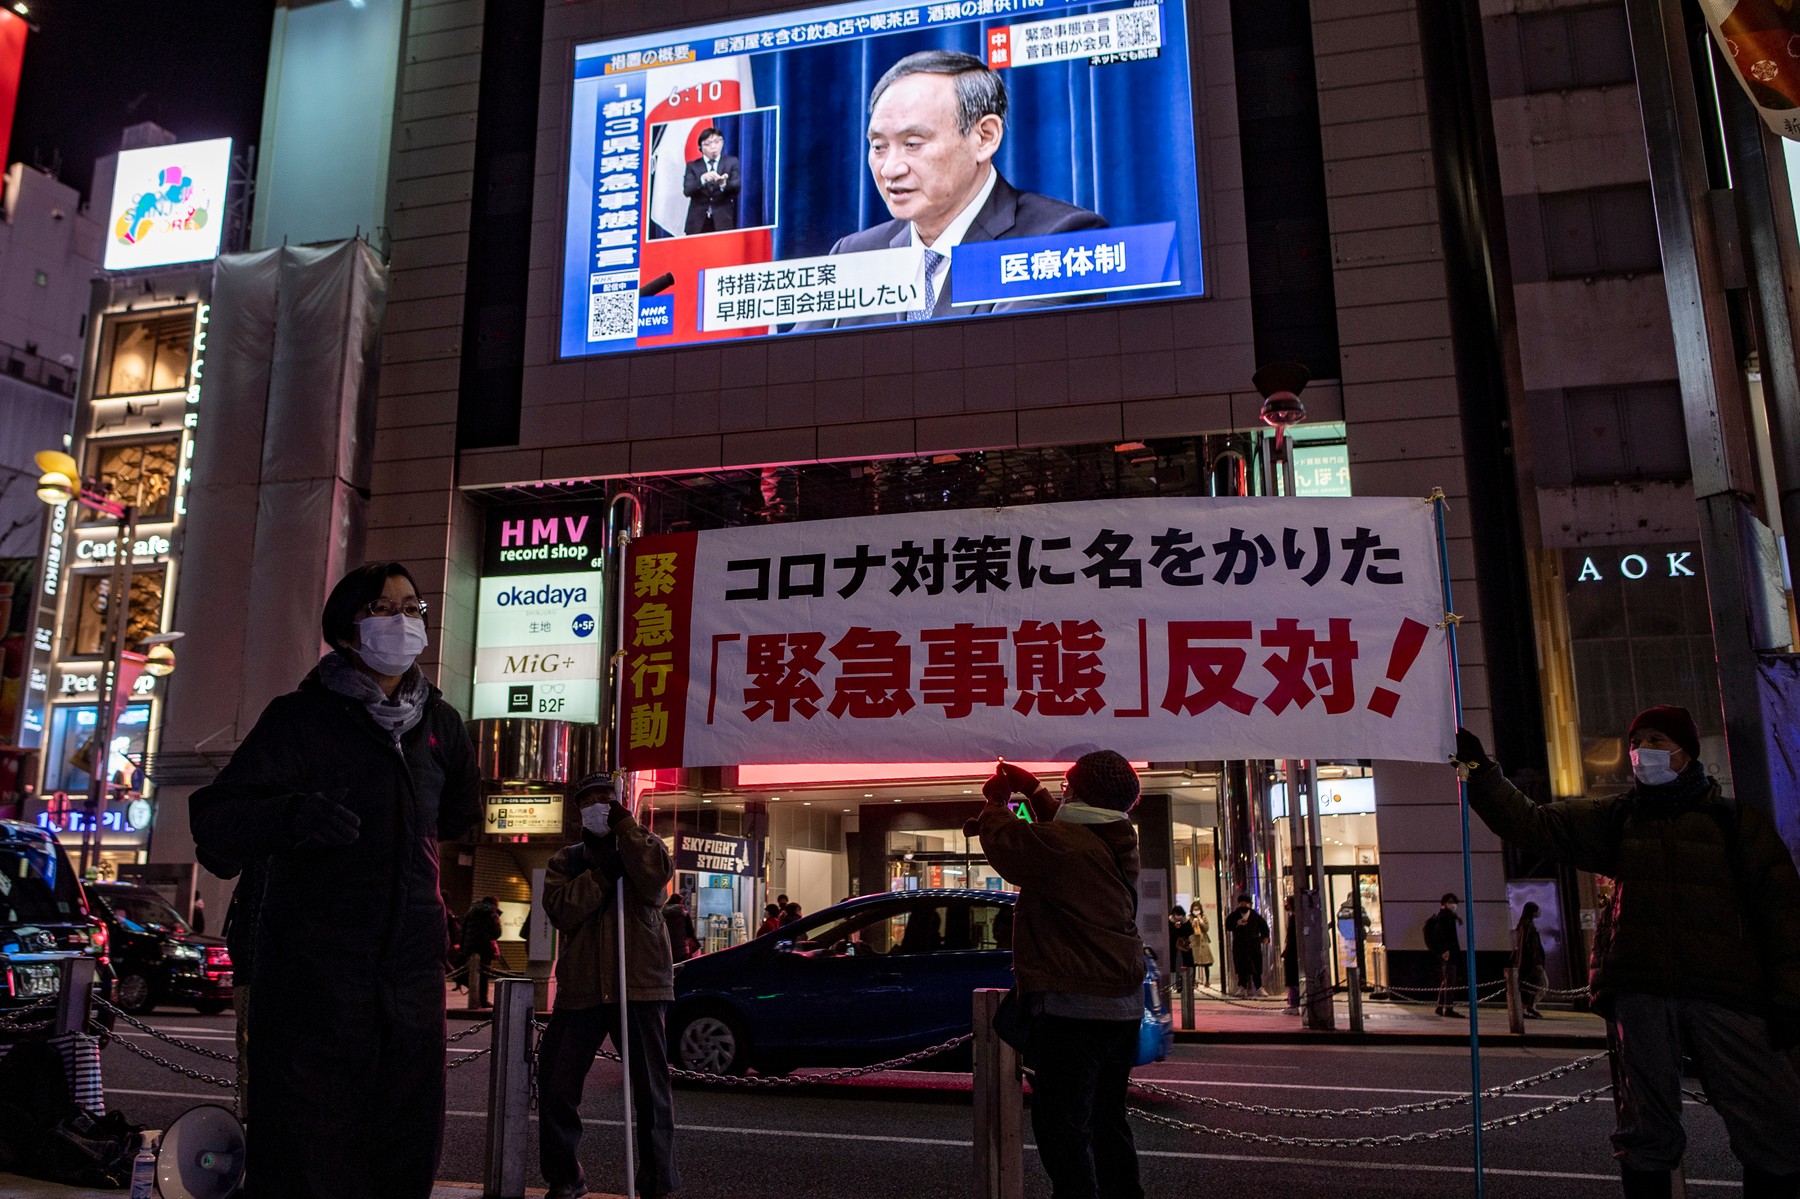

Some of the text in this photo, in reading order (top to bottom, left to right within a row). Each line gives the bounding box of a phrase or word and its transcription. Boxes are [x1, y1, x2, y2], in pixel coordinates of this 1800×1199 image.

[713, 9, 919, 55] 居酒屋を含む飲食店や喫茶店
[1025, 18, 1110, 42] 緊急事態宣言
[610, 43, 691, 71] 措置の概要
[991, 32, 1008, 63] 中継
[1026, 35, 1111, 60] 菅首相が会見
[668, 80, 722, 107] 6:10
[1000, 241, 1126, 284] 医療体制
[717, 264, 837, 297] 特措法改正案
[640, 306, 667, 317] NHK
[716, 283, 918, 322] 早期に国会提出したい
[638, 316, 669, 327] NEWS
[501, 516, 589, 547] HMV
[76, 540, 117, 559] Cat
[500, 544, 588, 562] record shop
[725, 526, 1404, 601] コロナ対策に名をかりた
[496, 584, 587, 608] okadaya
[529, 621, 552, 633] 生地
[630, 552, 678, 750] 緊急行動
[60, 673, 97, 693] Pet
[706, 616, 1430, 726] 「緊急事態」反対！
[538, 698, 565, 713] B2F
[696, 854, 736, 871] STORE
